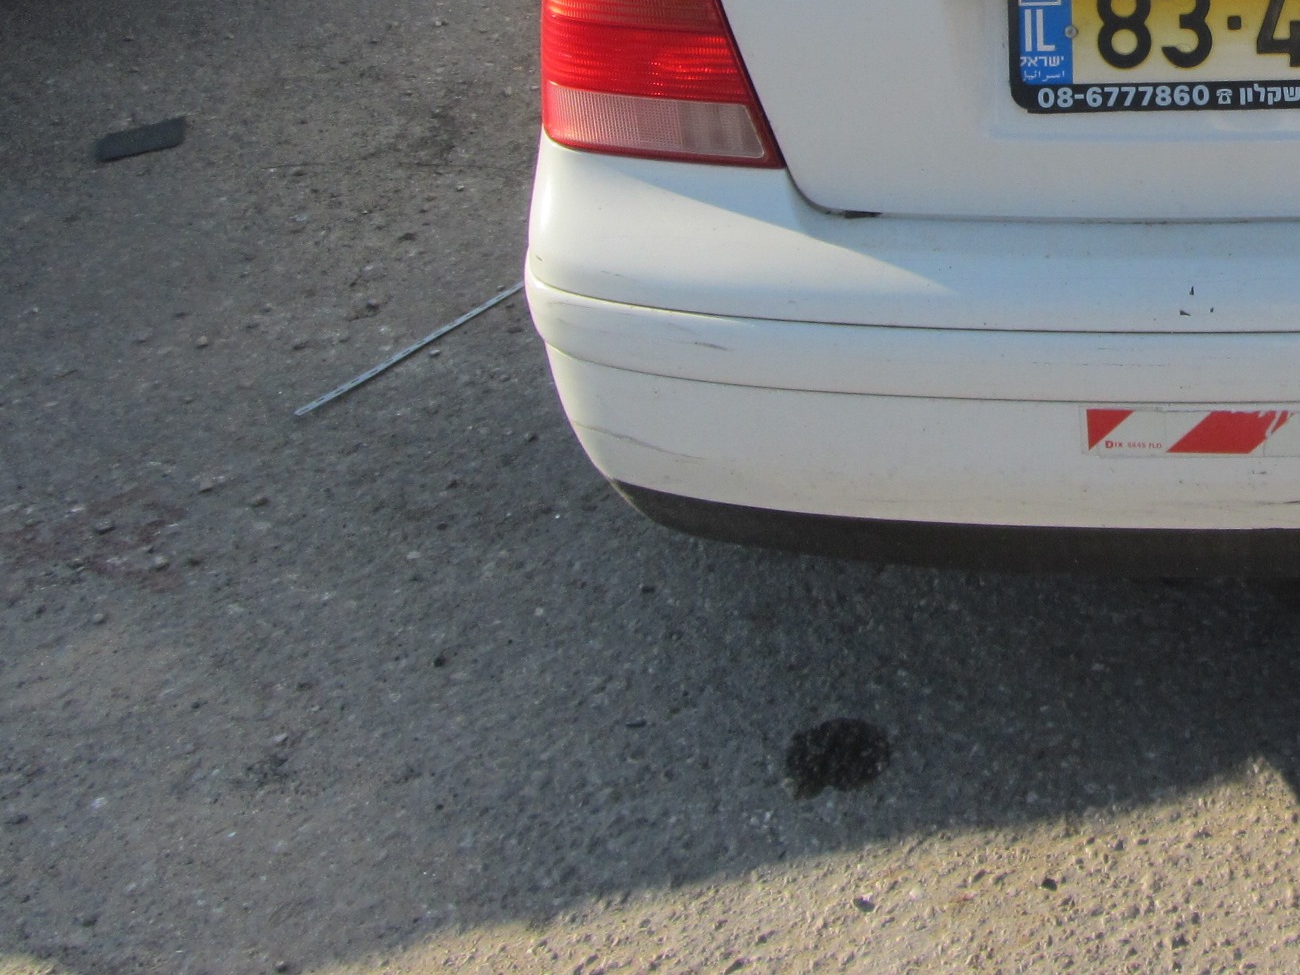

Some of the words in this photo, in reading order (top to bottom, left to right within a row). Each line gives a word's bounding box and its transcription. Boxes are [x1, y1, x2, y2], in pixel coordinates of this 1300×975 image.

[1024, 9, 1055, 51] IL
[1019, 56, 1064, 67] ישראל
[1038, 85, 1210, 107] 08-6777860
